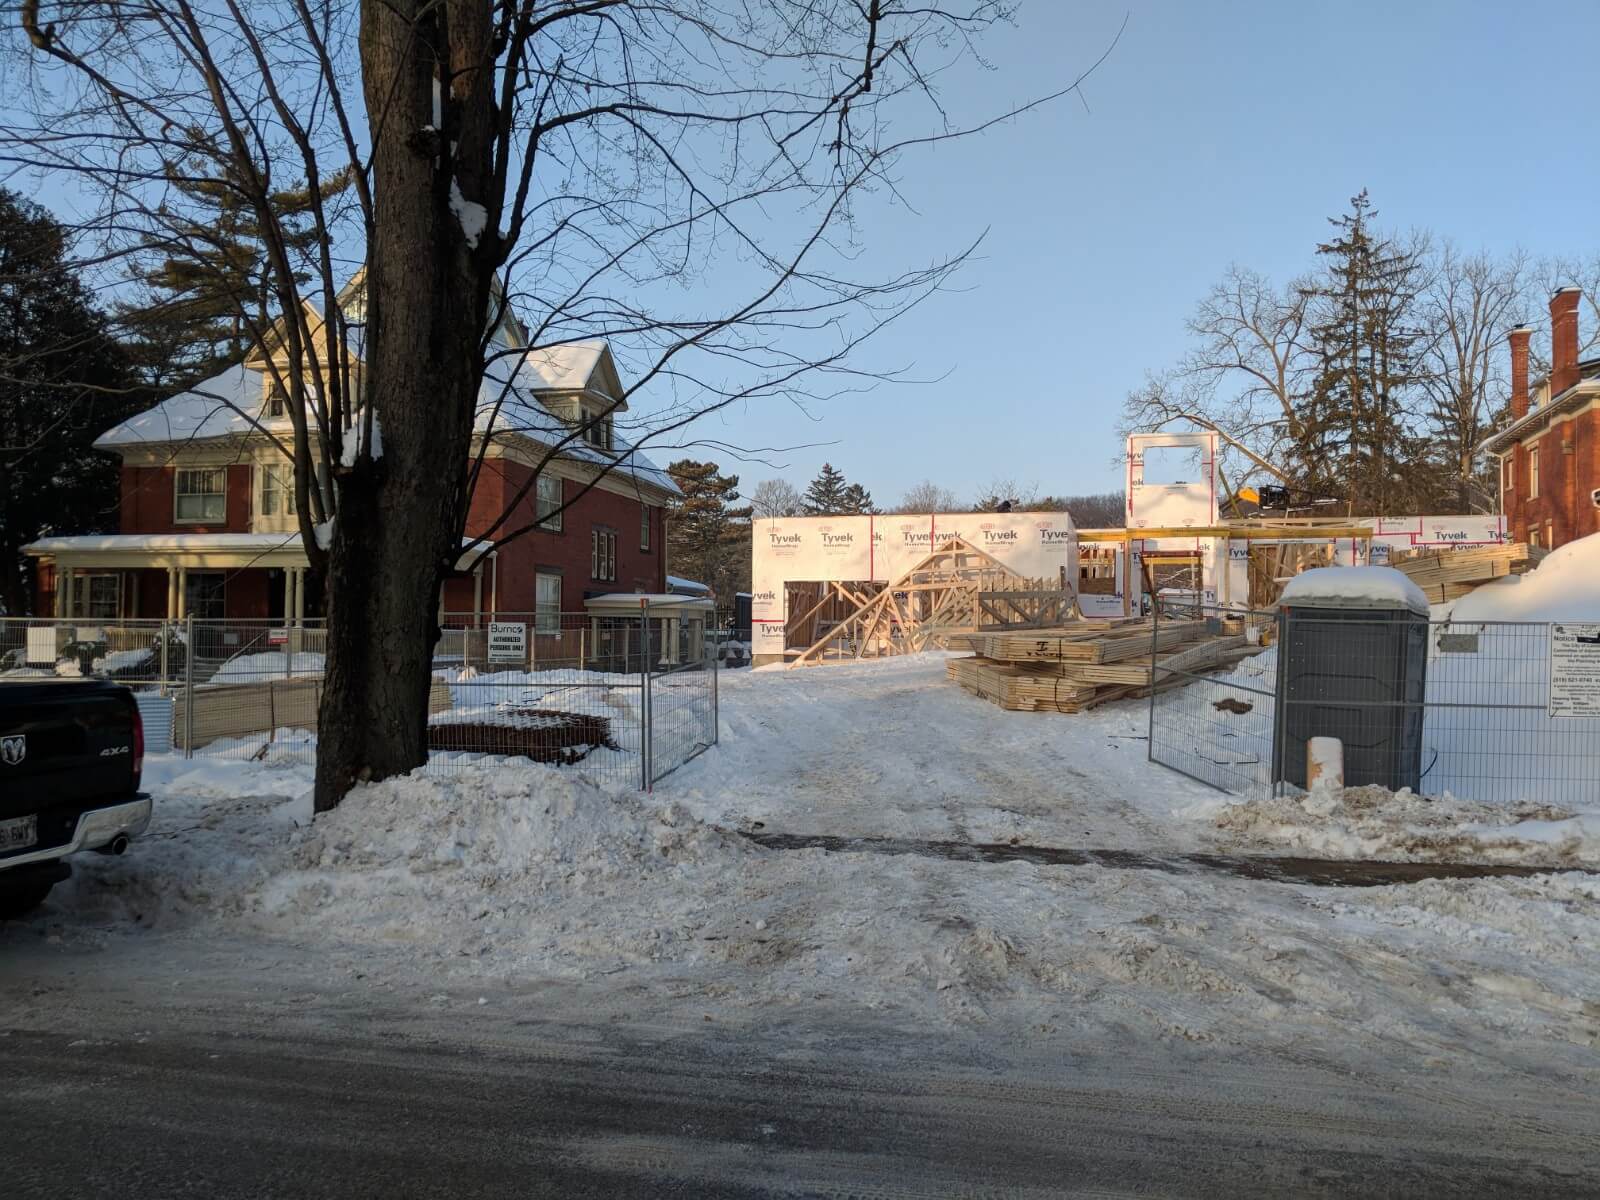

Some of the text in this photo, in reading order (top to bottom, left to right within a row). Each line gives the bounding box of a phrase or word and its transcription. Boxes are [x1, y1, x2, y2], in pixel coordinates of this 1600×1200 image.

[770, 533, 801, 544] Tyvek
[821, 533, 853, 543] Tyvek
[983, 530, 1017, 541] Tyvek
[1435, 531, 1468, 540] Tyvek
